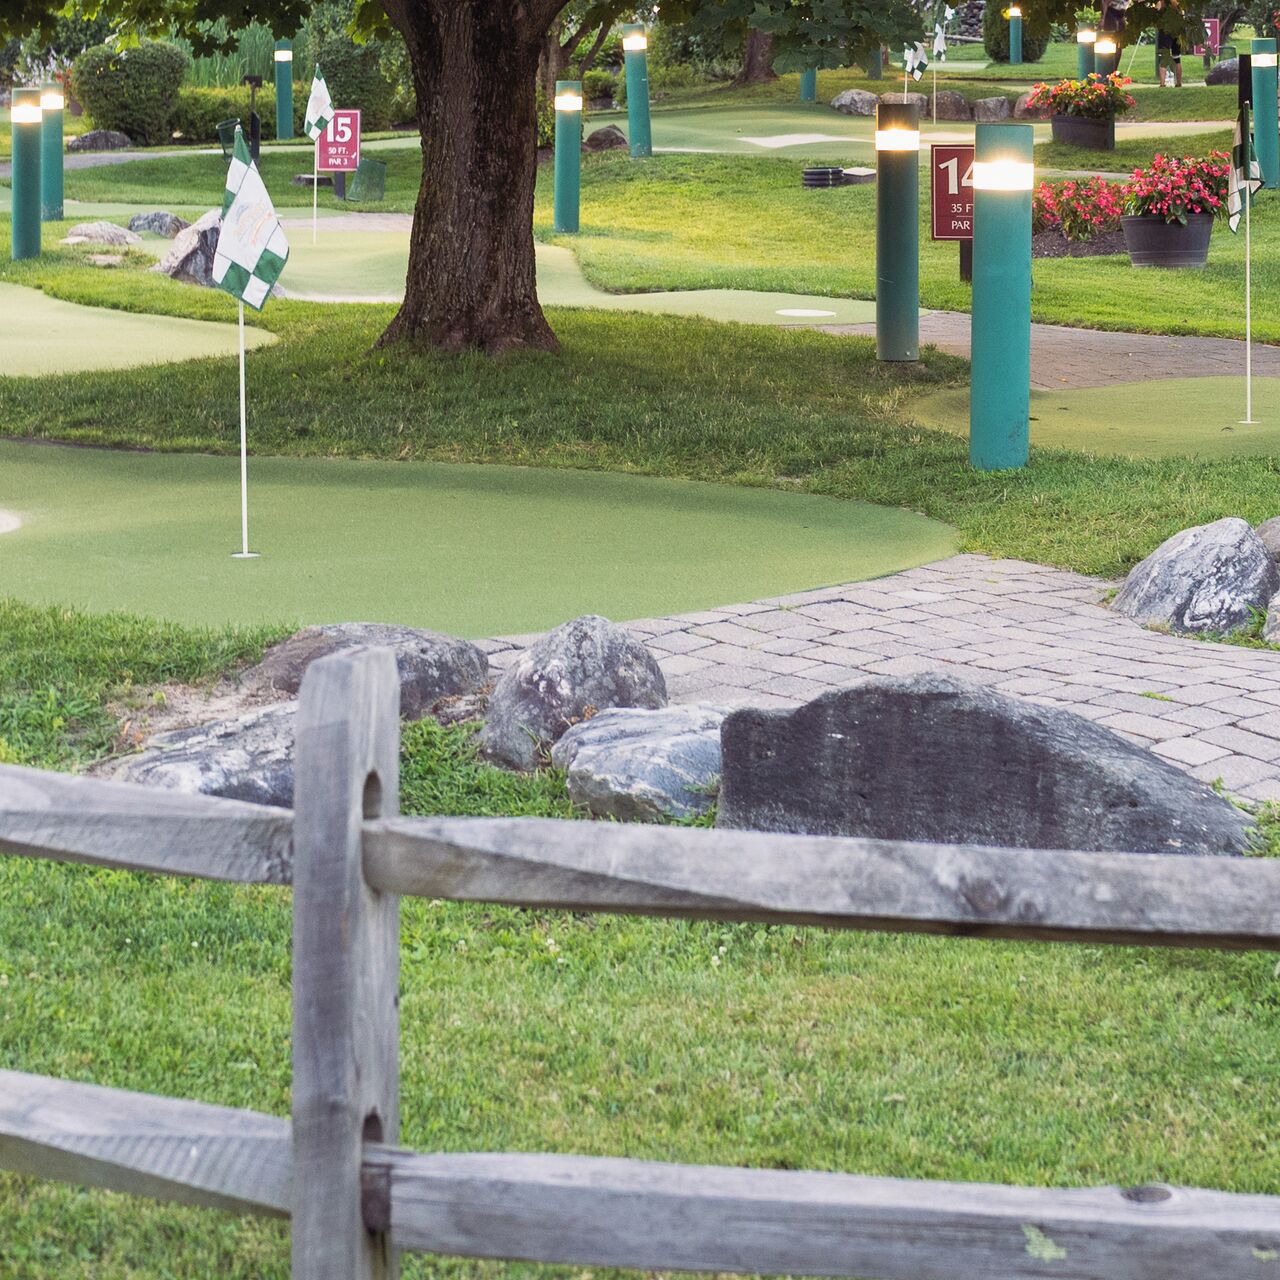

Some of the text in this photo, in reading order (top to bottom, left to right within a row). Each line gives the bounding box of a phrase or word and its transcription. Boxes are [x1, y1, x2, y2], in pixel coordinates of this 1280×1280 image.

[327, 117, 352, 142] 15
[328, 158, 341, 166] PAR
[951, 204, 962, 213] 35
[951, 221, 971, 230] PAR
